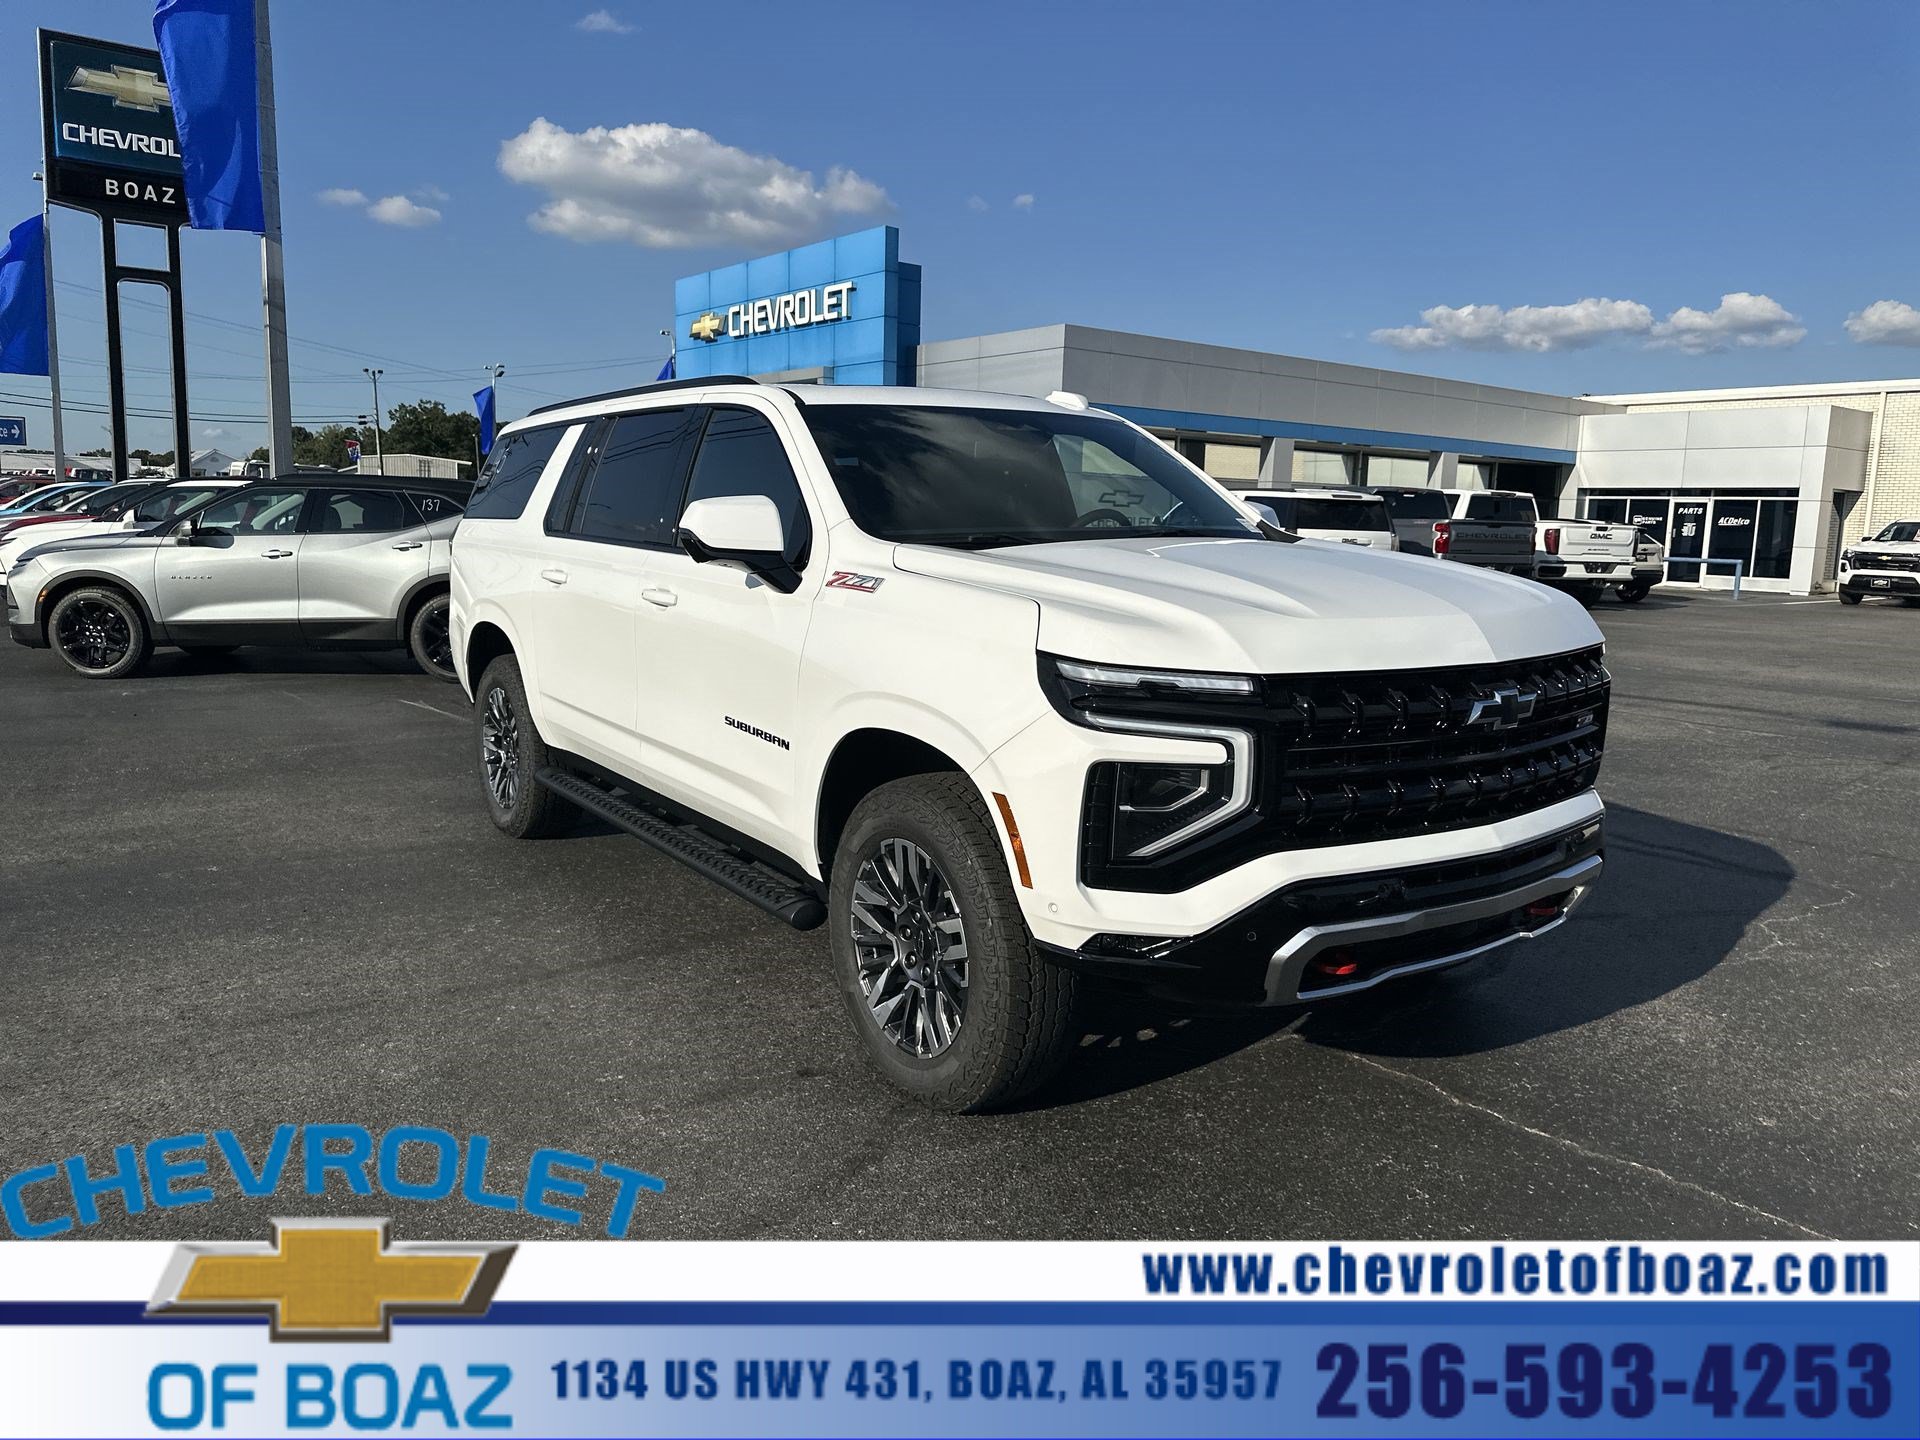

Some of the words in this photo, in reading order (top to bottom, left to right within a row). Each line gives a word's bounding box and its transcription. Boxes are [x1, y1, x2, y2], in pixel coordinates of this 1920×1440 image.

[62, 122, 181, 158] CHEVROL
[105, 178, 175, 204] BOAZ
[727, 281, 855, 337] CHEVROLET
[422, 498, 440, 511] 137
[1678, 507, 1703, 515] PARTS
[1717, 516, 1750, 526] ACDelco
[1456, 532, 1530, 540] CHEVROLET
[825, 570, 886, 594] Z71
[724, 715, 790, 751] SUBURBAN
